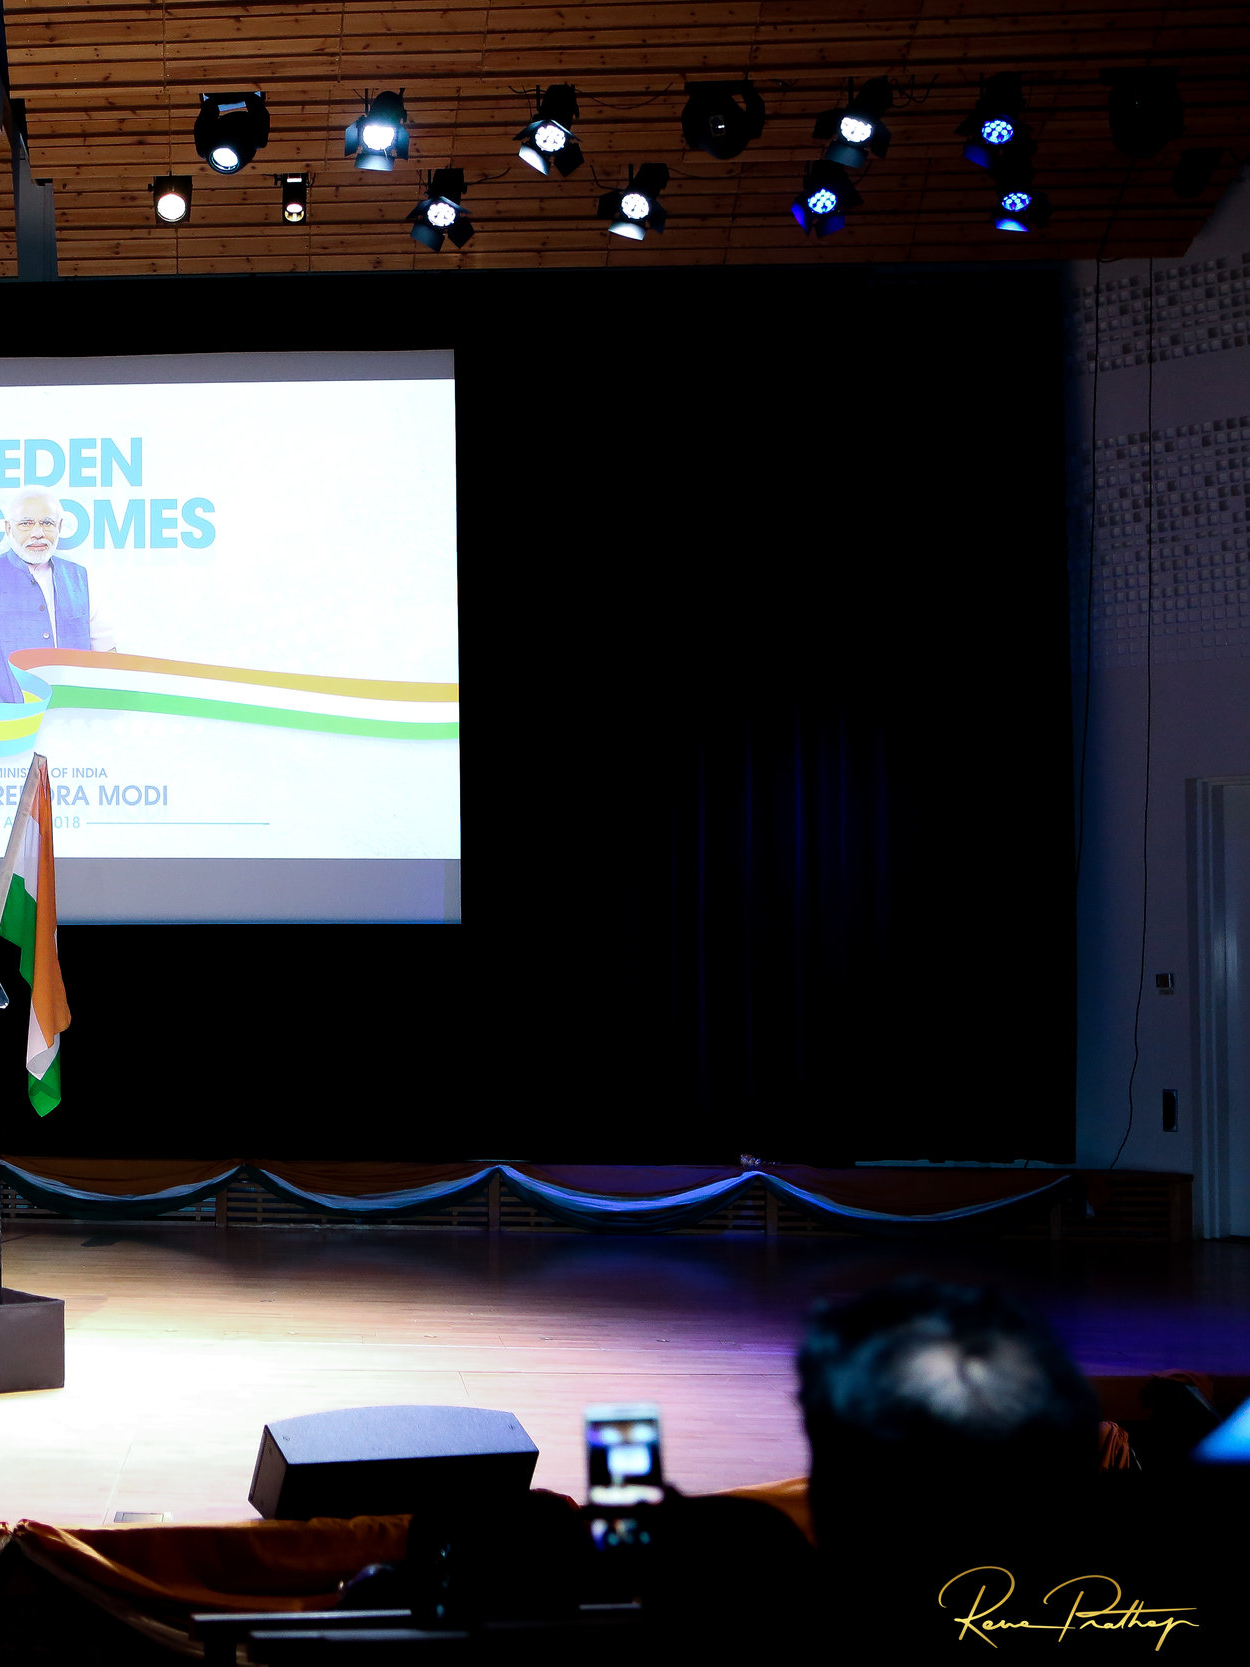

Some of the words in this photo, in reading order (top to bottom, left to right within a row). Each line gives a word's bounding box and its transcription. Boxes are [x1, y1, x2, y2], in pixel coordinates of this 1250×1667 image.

[50, 767, 68, 779] OF
[72, 767, 109, 779] INDIA
[98, 784, 168, 806] MODI
[51, 815, 81, 829] 018
